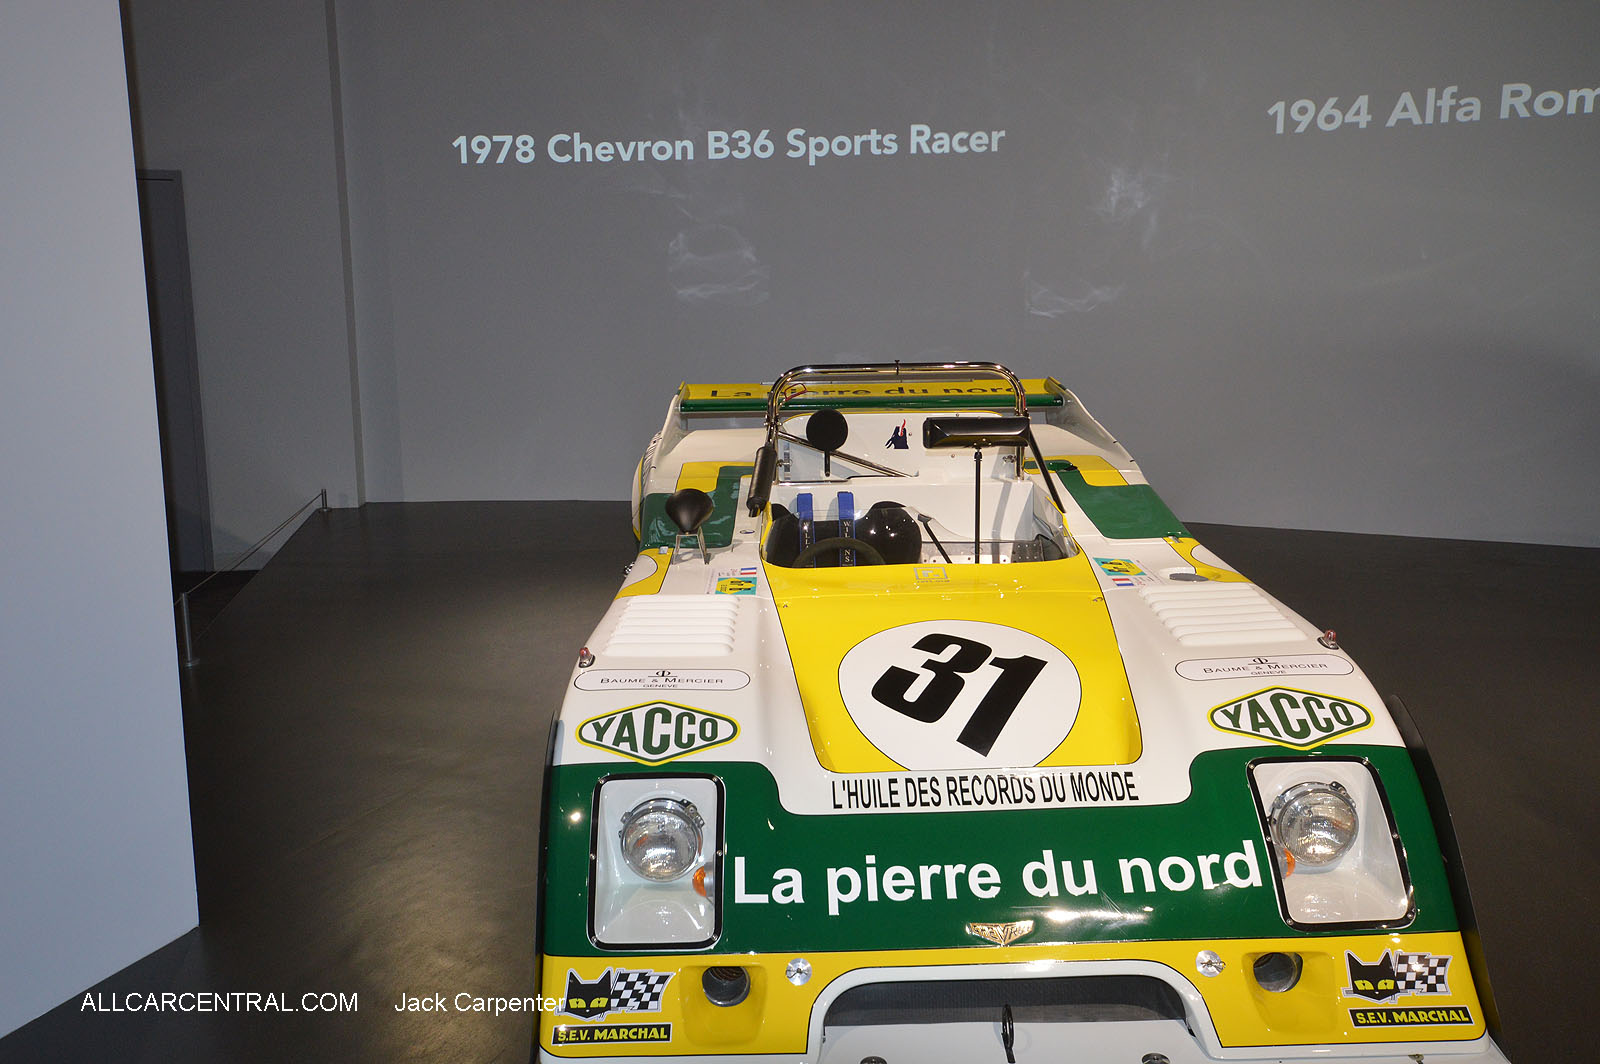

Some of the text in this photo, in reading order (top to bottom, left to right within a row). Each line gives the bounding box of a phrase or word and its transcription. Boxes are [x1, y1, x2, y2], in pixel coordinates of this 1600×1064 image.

[1267, 94, 1372, 135] 1964
[1385, 85, 1482, 128] Alfa
[452, 123, 1006, 165] 1978 Chevron B36 Sports Racer
[1203, 665, 1250, 674] BAUME
[1267, 663, 1328, 671] MERCIER
[871, 633, 1049, 757] 31
[1220, 692, 1354, 740] YACCO
[592, 707, 719, 755] YACCO
[831, 770, 1140, 810] L'HUILE DES RECORDS DU MONDE
[734, 839, 1263, 916] La pierre du nord
[557, 1027, 668, 1042] S.E.V. MARCHAL
[1355, 1009, 1470, 1024] S.E.V. MARCHAL
